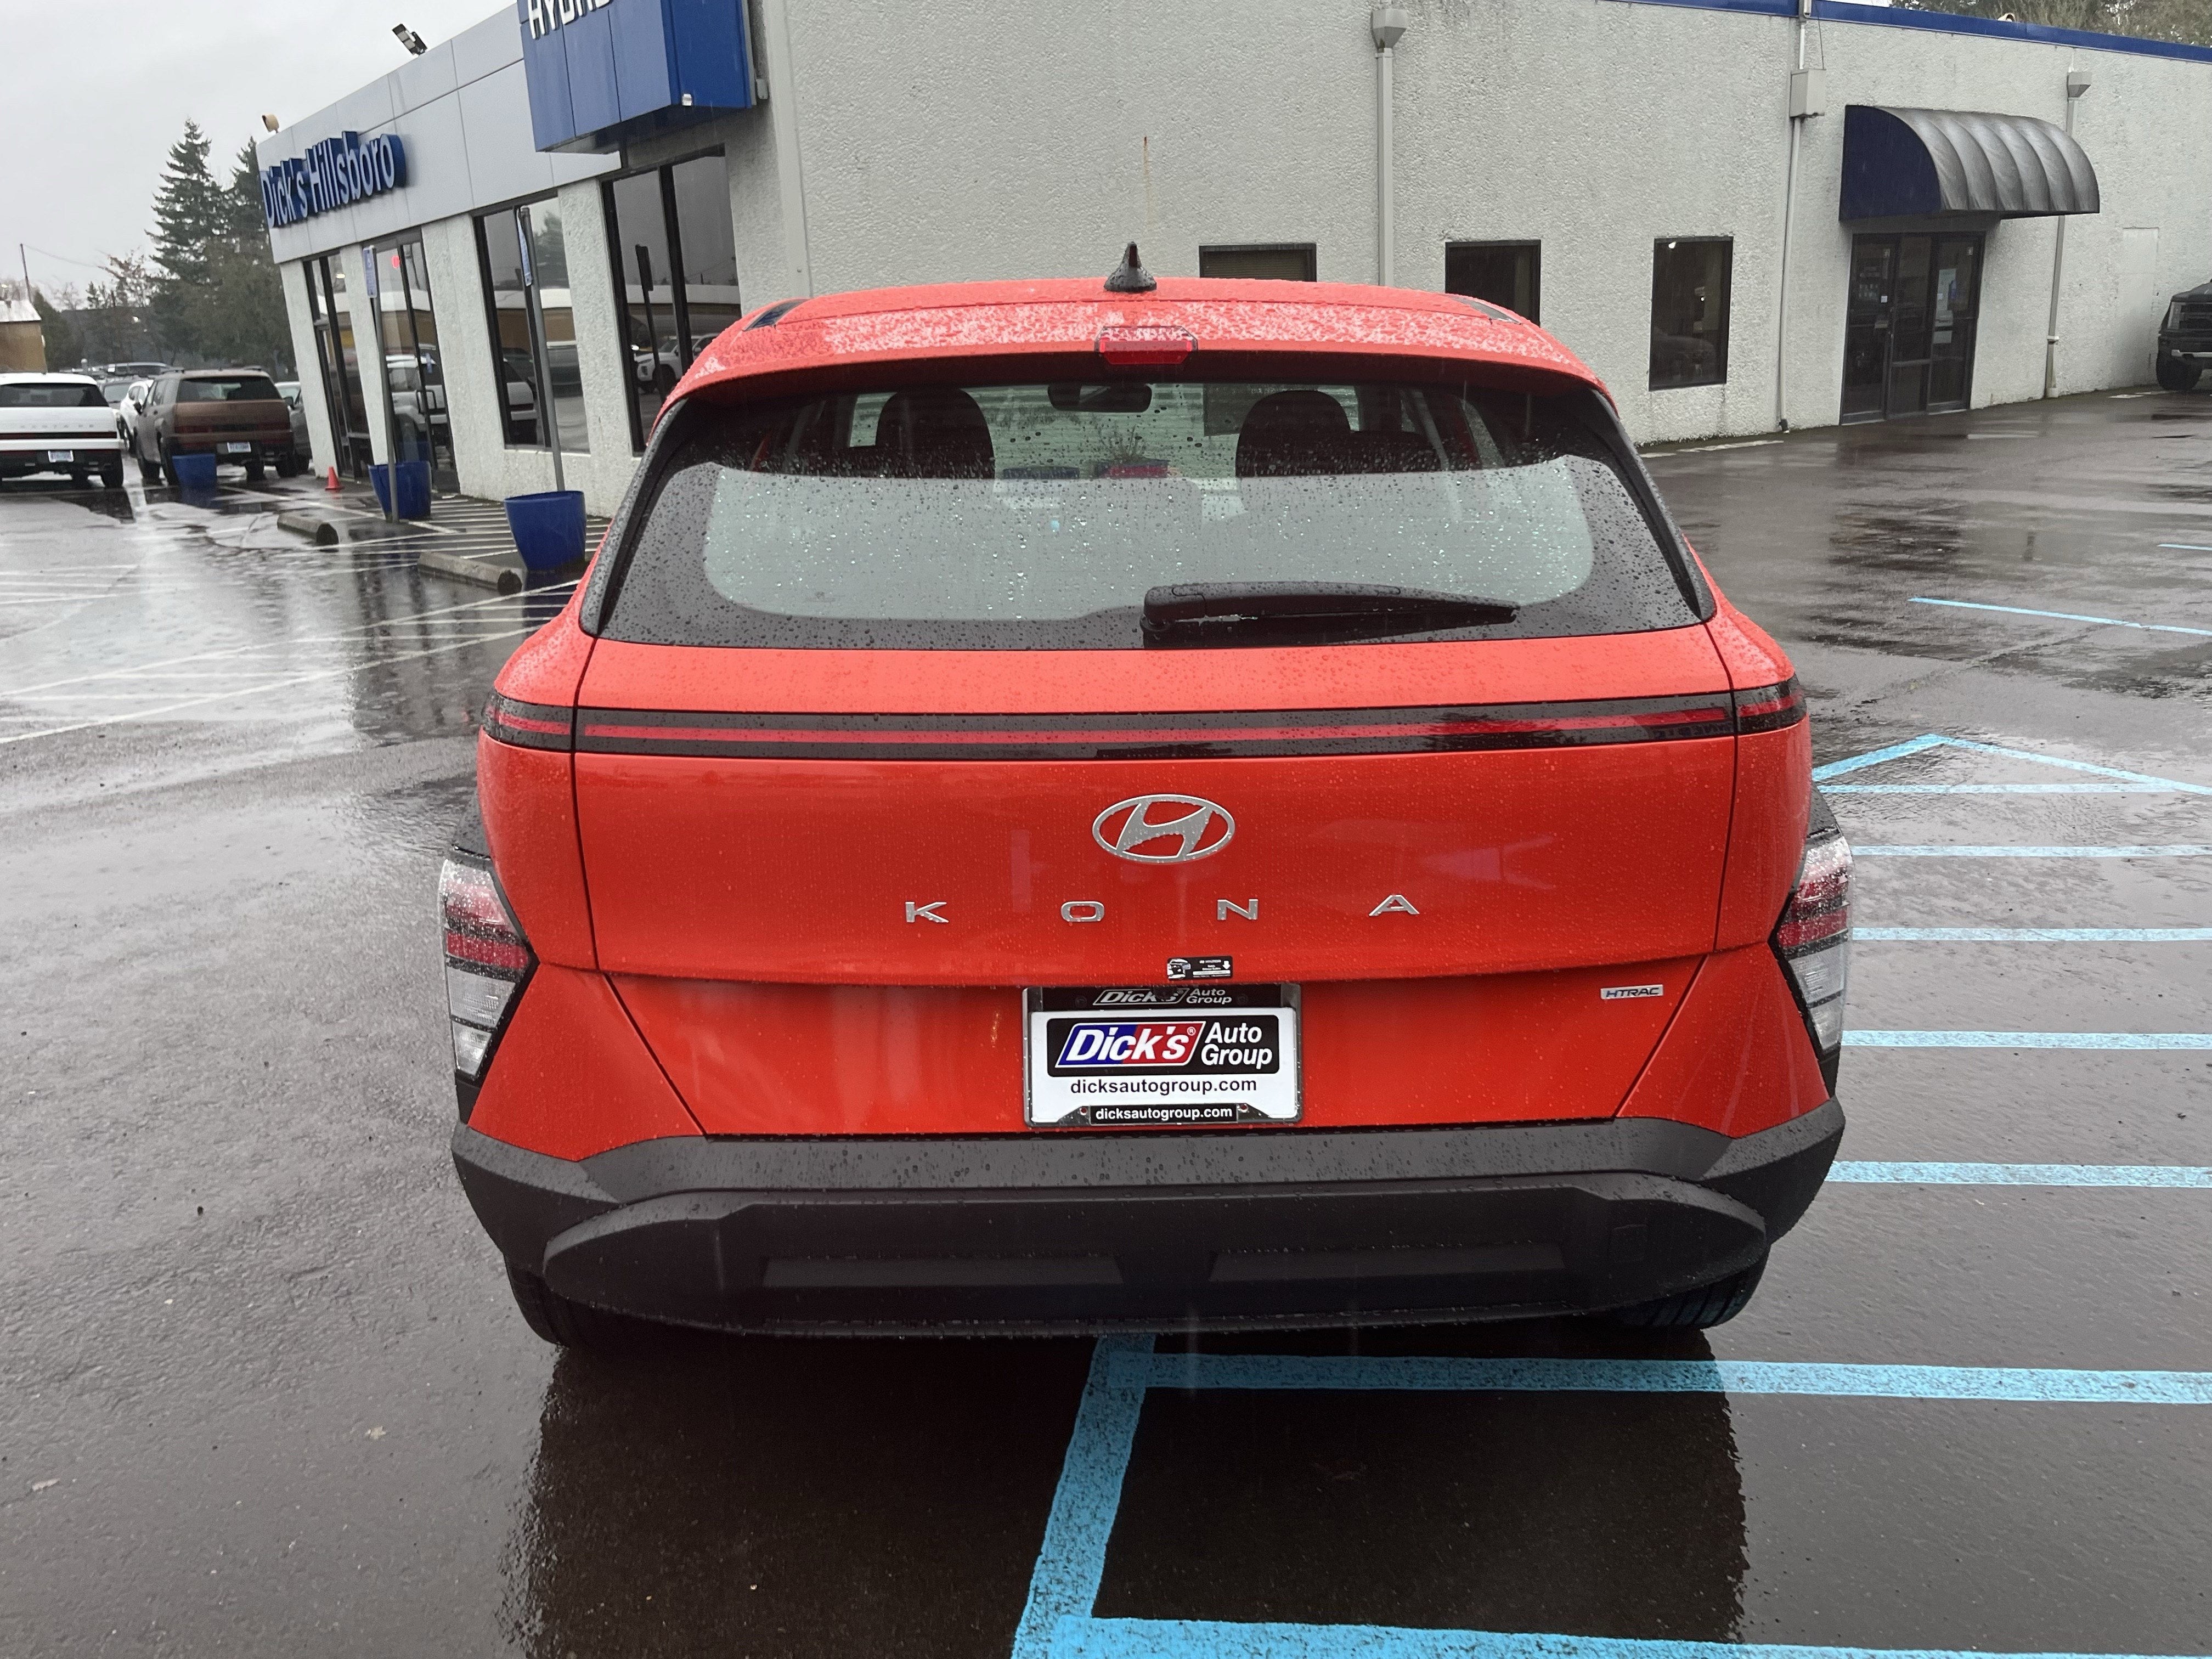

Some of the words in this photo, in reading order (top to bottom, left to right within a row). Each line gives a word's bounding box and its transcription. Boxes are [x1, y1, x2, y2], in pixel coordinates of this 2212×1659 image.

[260, 159, 308, 228] Dick's
[305, 131, 395, 213] Hillsboro
[905, 894, 1420, 924] KONA
[1186, 996, 1232, 1005] Group
[1605, 988, 1660, 997] HTRAC
[1205, 1022, 1262, 1043] Auto
[1065, 1026, 1189, 1061] Dick's
[1201, 1043, 1272, 1069] Group
[1070, 1079, 1257, 1096] dicksautogroup.com
[1096, 1108, 1232, 1121] dicksautogroup.com
